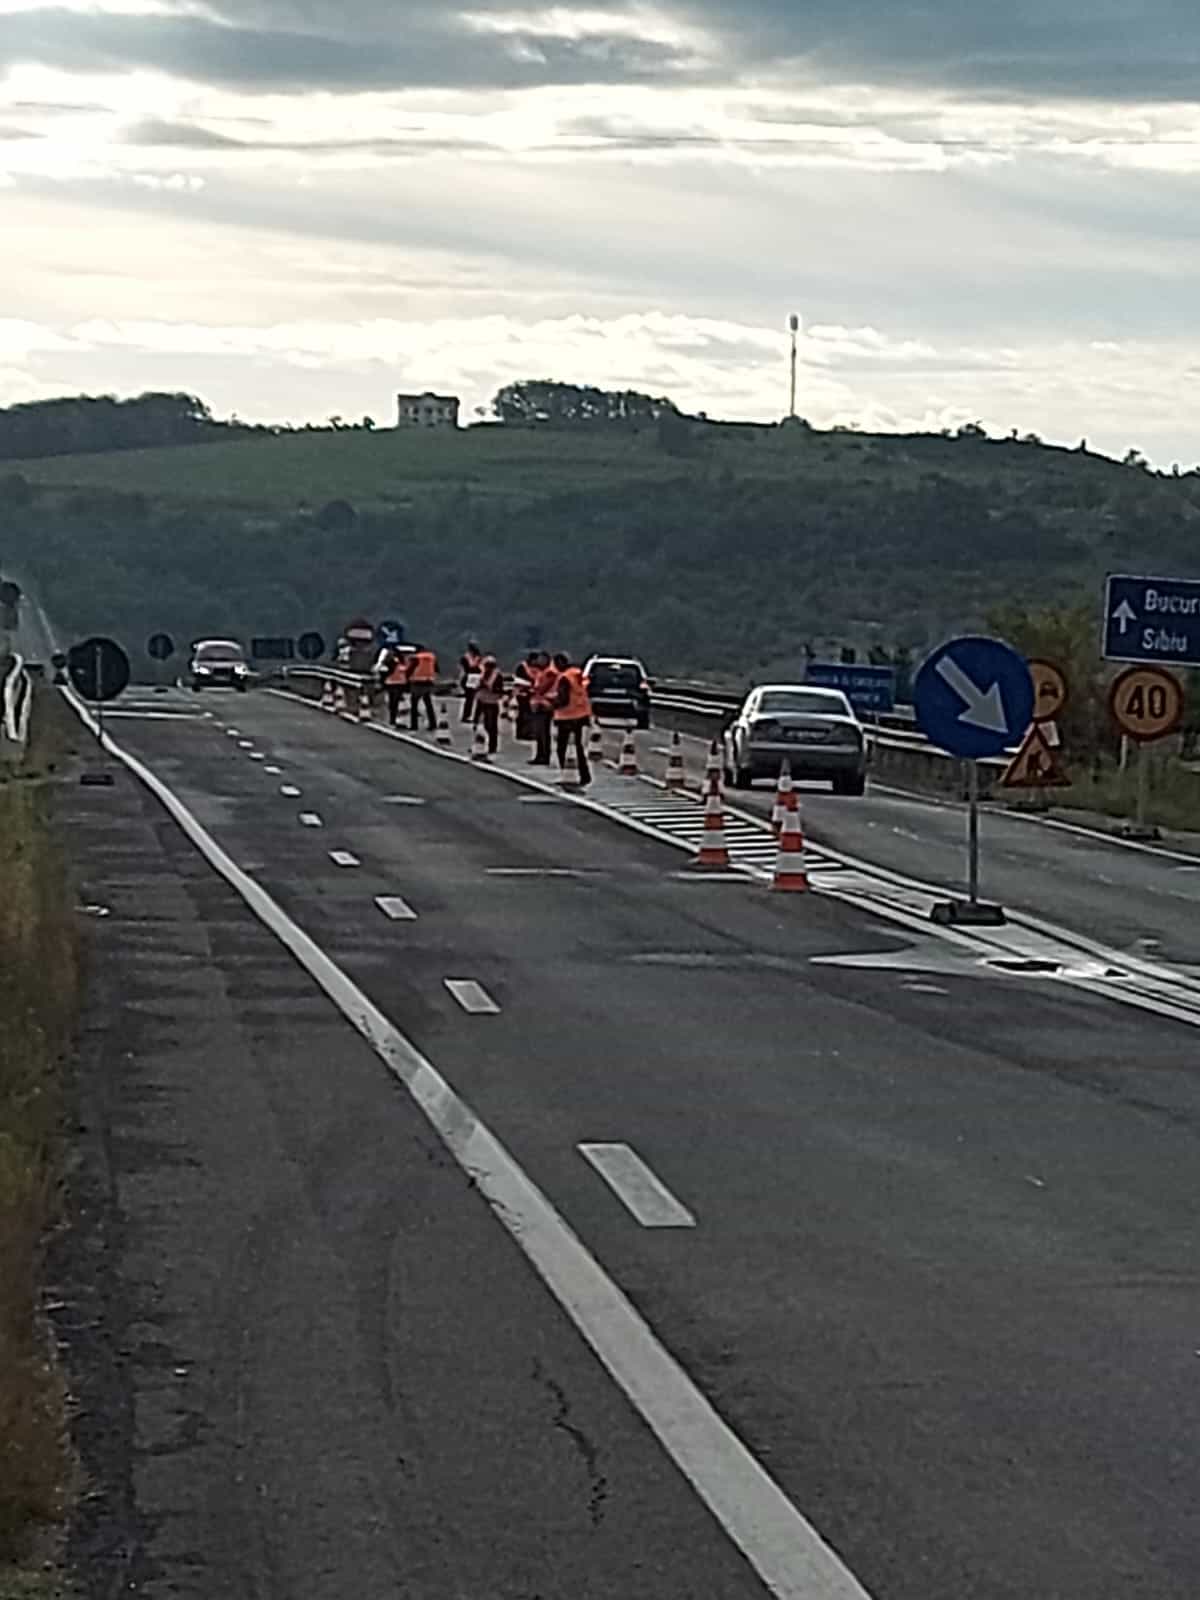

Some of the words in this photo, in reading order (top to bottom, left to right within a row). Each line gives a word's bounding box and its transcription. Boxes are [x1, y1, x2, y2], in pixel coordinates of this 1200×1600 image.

[1144, 588, 1200, 614] Bucur
[1142, 628, 1188, 652] Sibiu
[1126, 685, 1167, 720] 40
